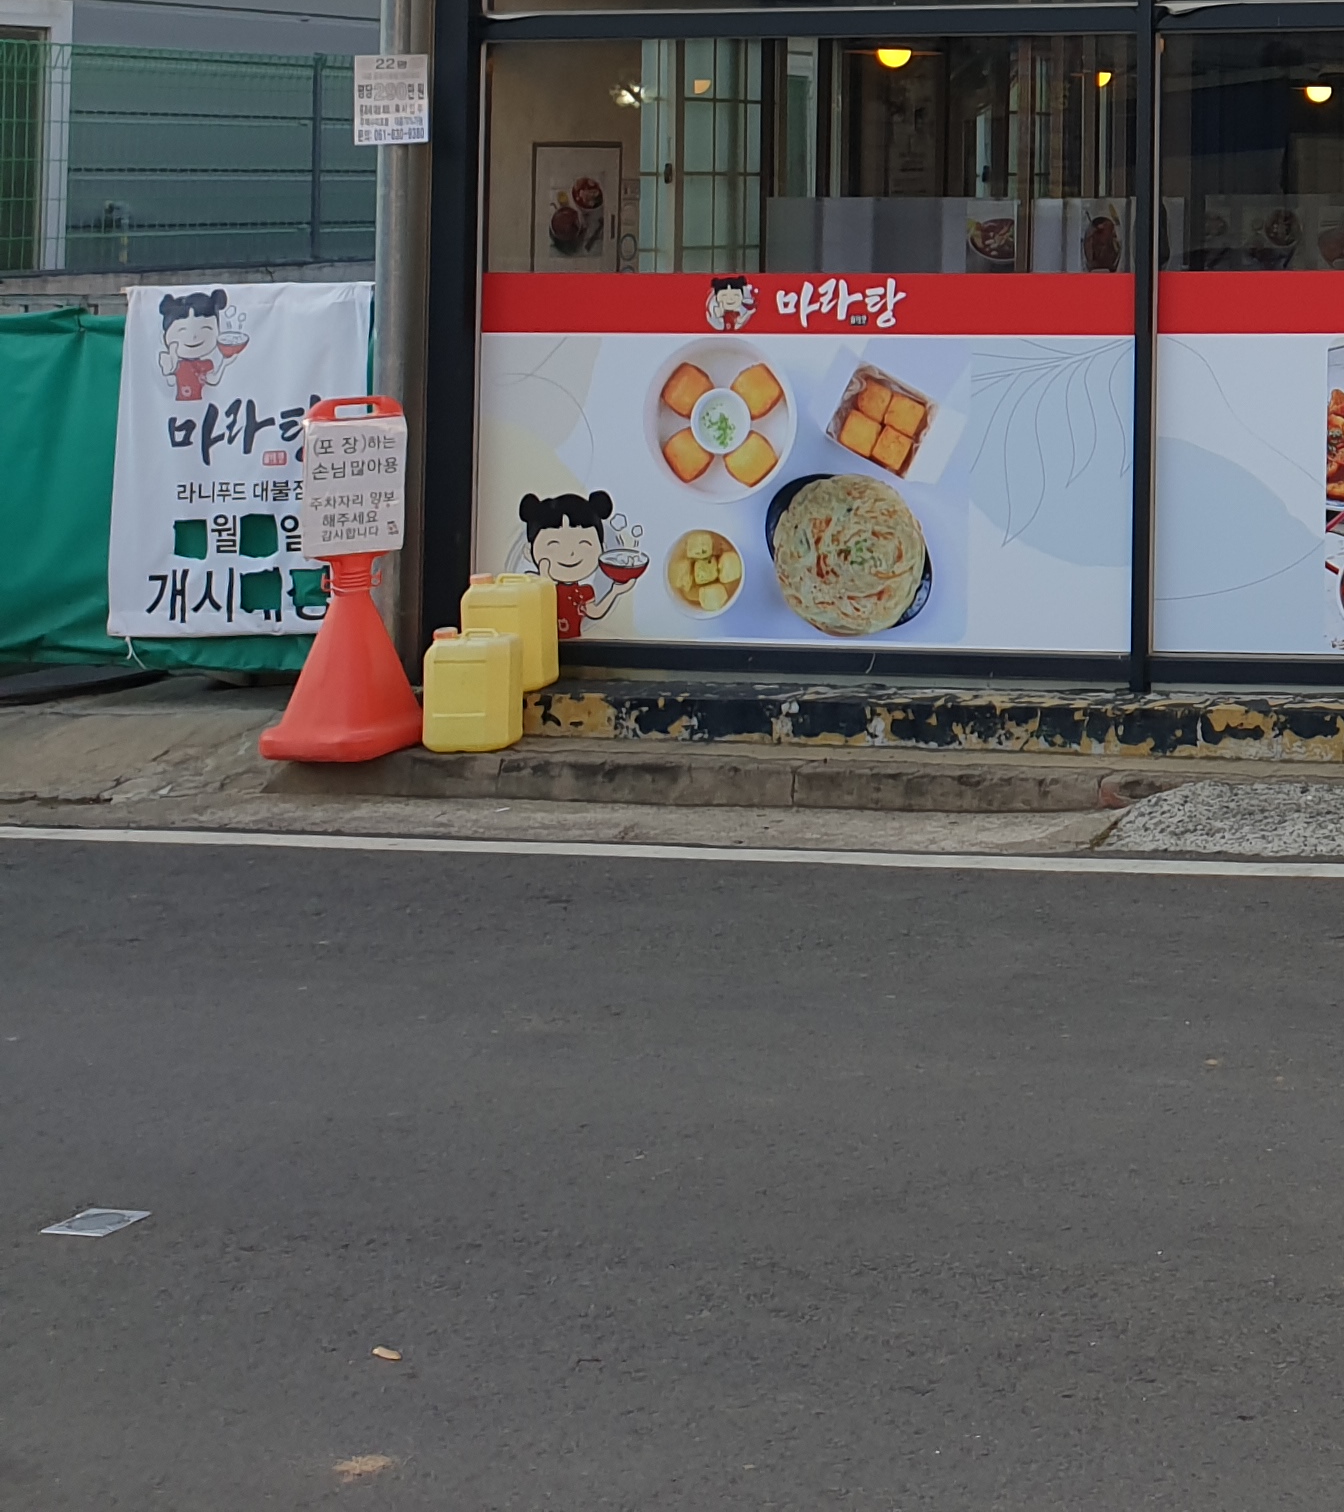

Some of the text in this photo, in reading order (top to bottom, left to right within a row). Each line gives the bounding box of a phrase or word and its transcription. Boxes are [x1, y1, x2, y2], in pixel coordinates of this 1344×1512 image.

[776, 278, 907, 328] 마라탕
[177, 482, 247, 503] 라니푸드
[322, 510, 379, 527] 해주세요
[321, 525, 380, 543] 감사합니다
